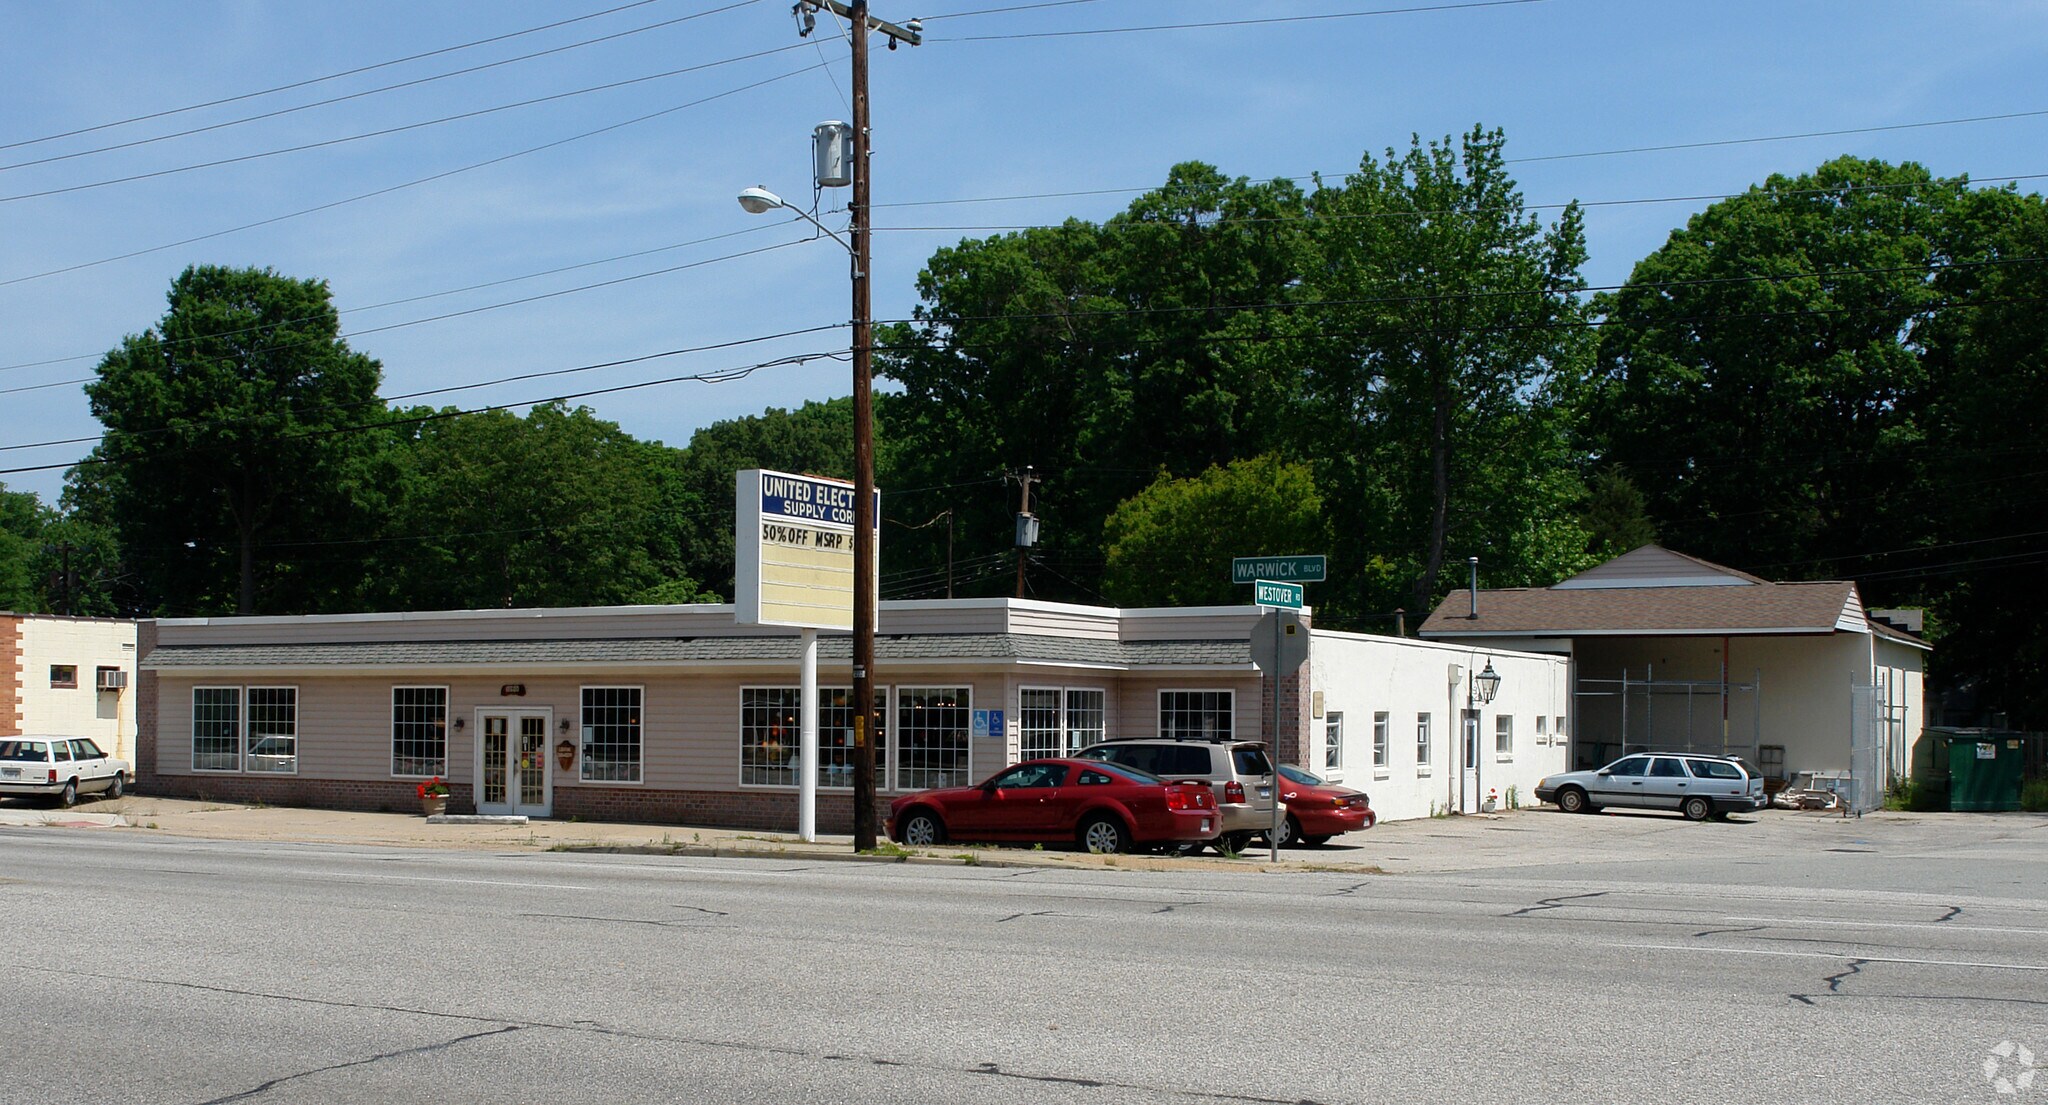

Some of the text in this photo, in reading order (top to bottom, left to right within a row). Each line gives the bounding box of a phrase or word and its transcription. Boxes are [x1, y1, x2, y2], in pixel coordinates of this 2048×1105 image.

[764, 476, 811, 501] UNITED
[784, 500, 855, 523] SUPPLY COR
[815, 533, 843, 549] MSRP
[1237, 562, 1322, 577] WARWICK BLVD
[1258, 586, 1292, 603] WESTOVER
